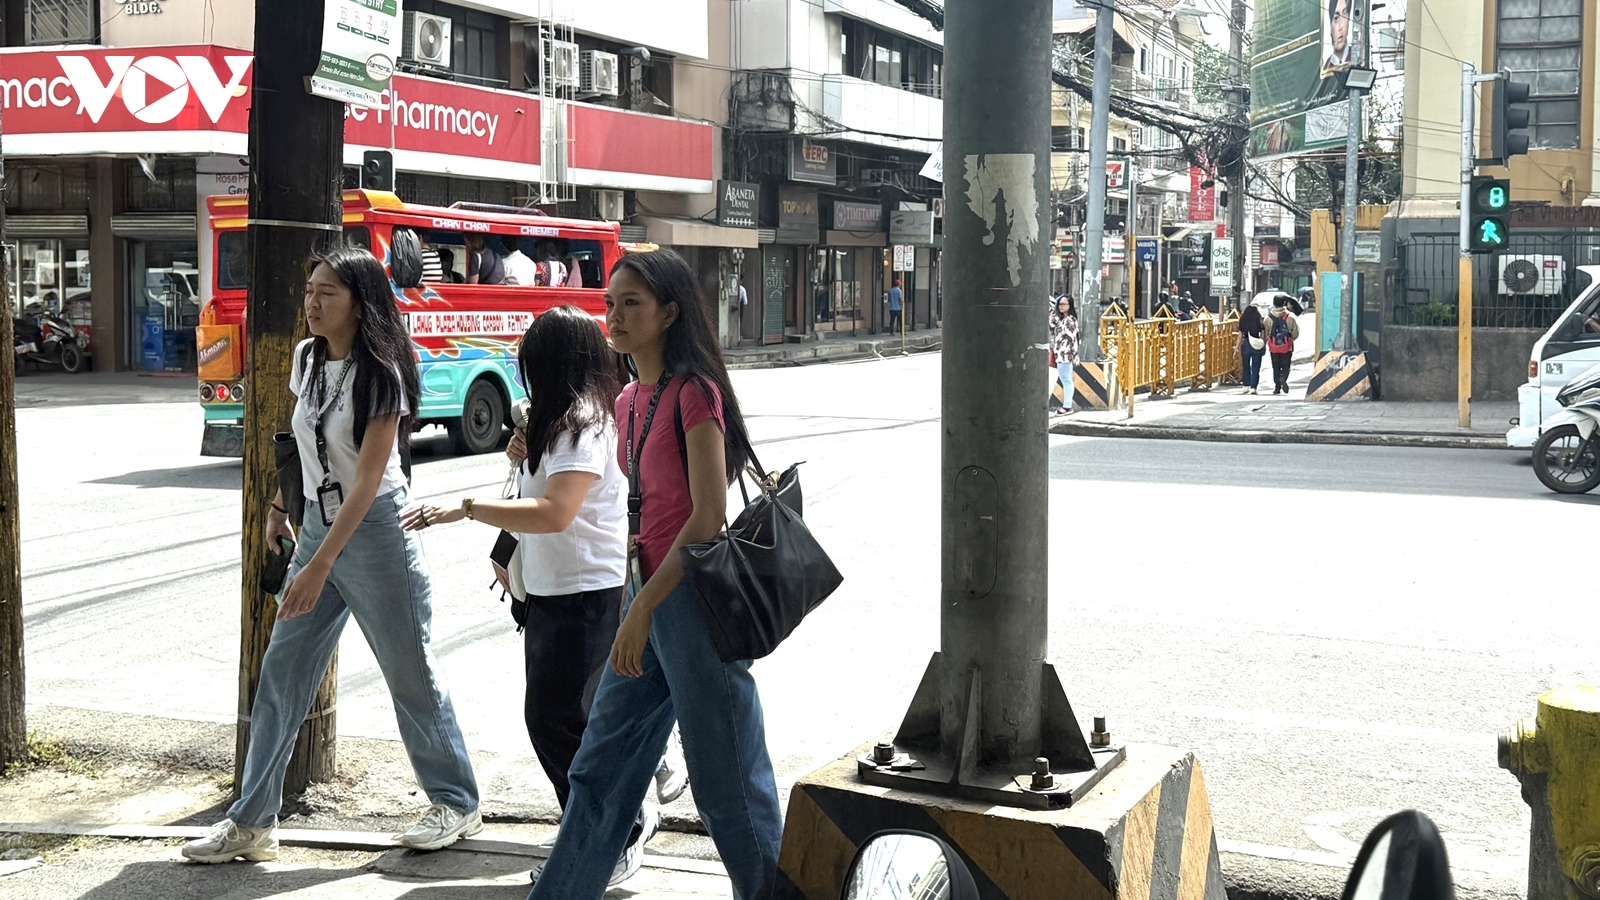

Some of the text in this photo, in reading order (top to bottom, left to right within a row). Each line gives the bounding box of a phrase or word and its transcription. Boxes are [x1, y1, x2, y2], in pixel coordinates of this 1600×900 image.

[125, 1, 161, 15] BLDG.
[377, 88, 499, 145] Pharmacy
[215, 173, 238, 183] Rose
[725, 183, 755, 201] ARANETA
[1490, 186, 1504, 208] 8
[731, 199, 749, 209] DENTAL
[846, 206, 880, 221] TIMETABLE
[432, 219, 559, 237] CHAN CHAN CHIEMER
[1143, 253, 1156, 261] dry
[1214, 261, 1230, 269] BIKE
[435, 315, 456, 333] PLAZA
[482, 314, 505, 332] CARBON
